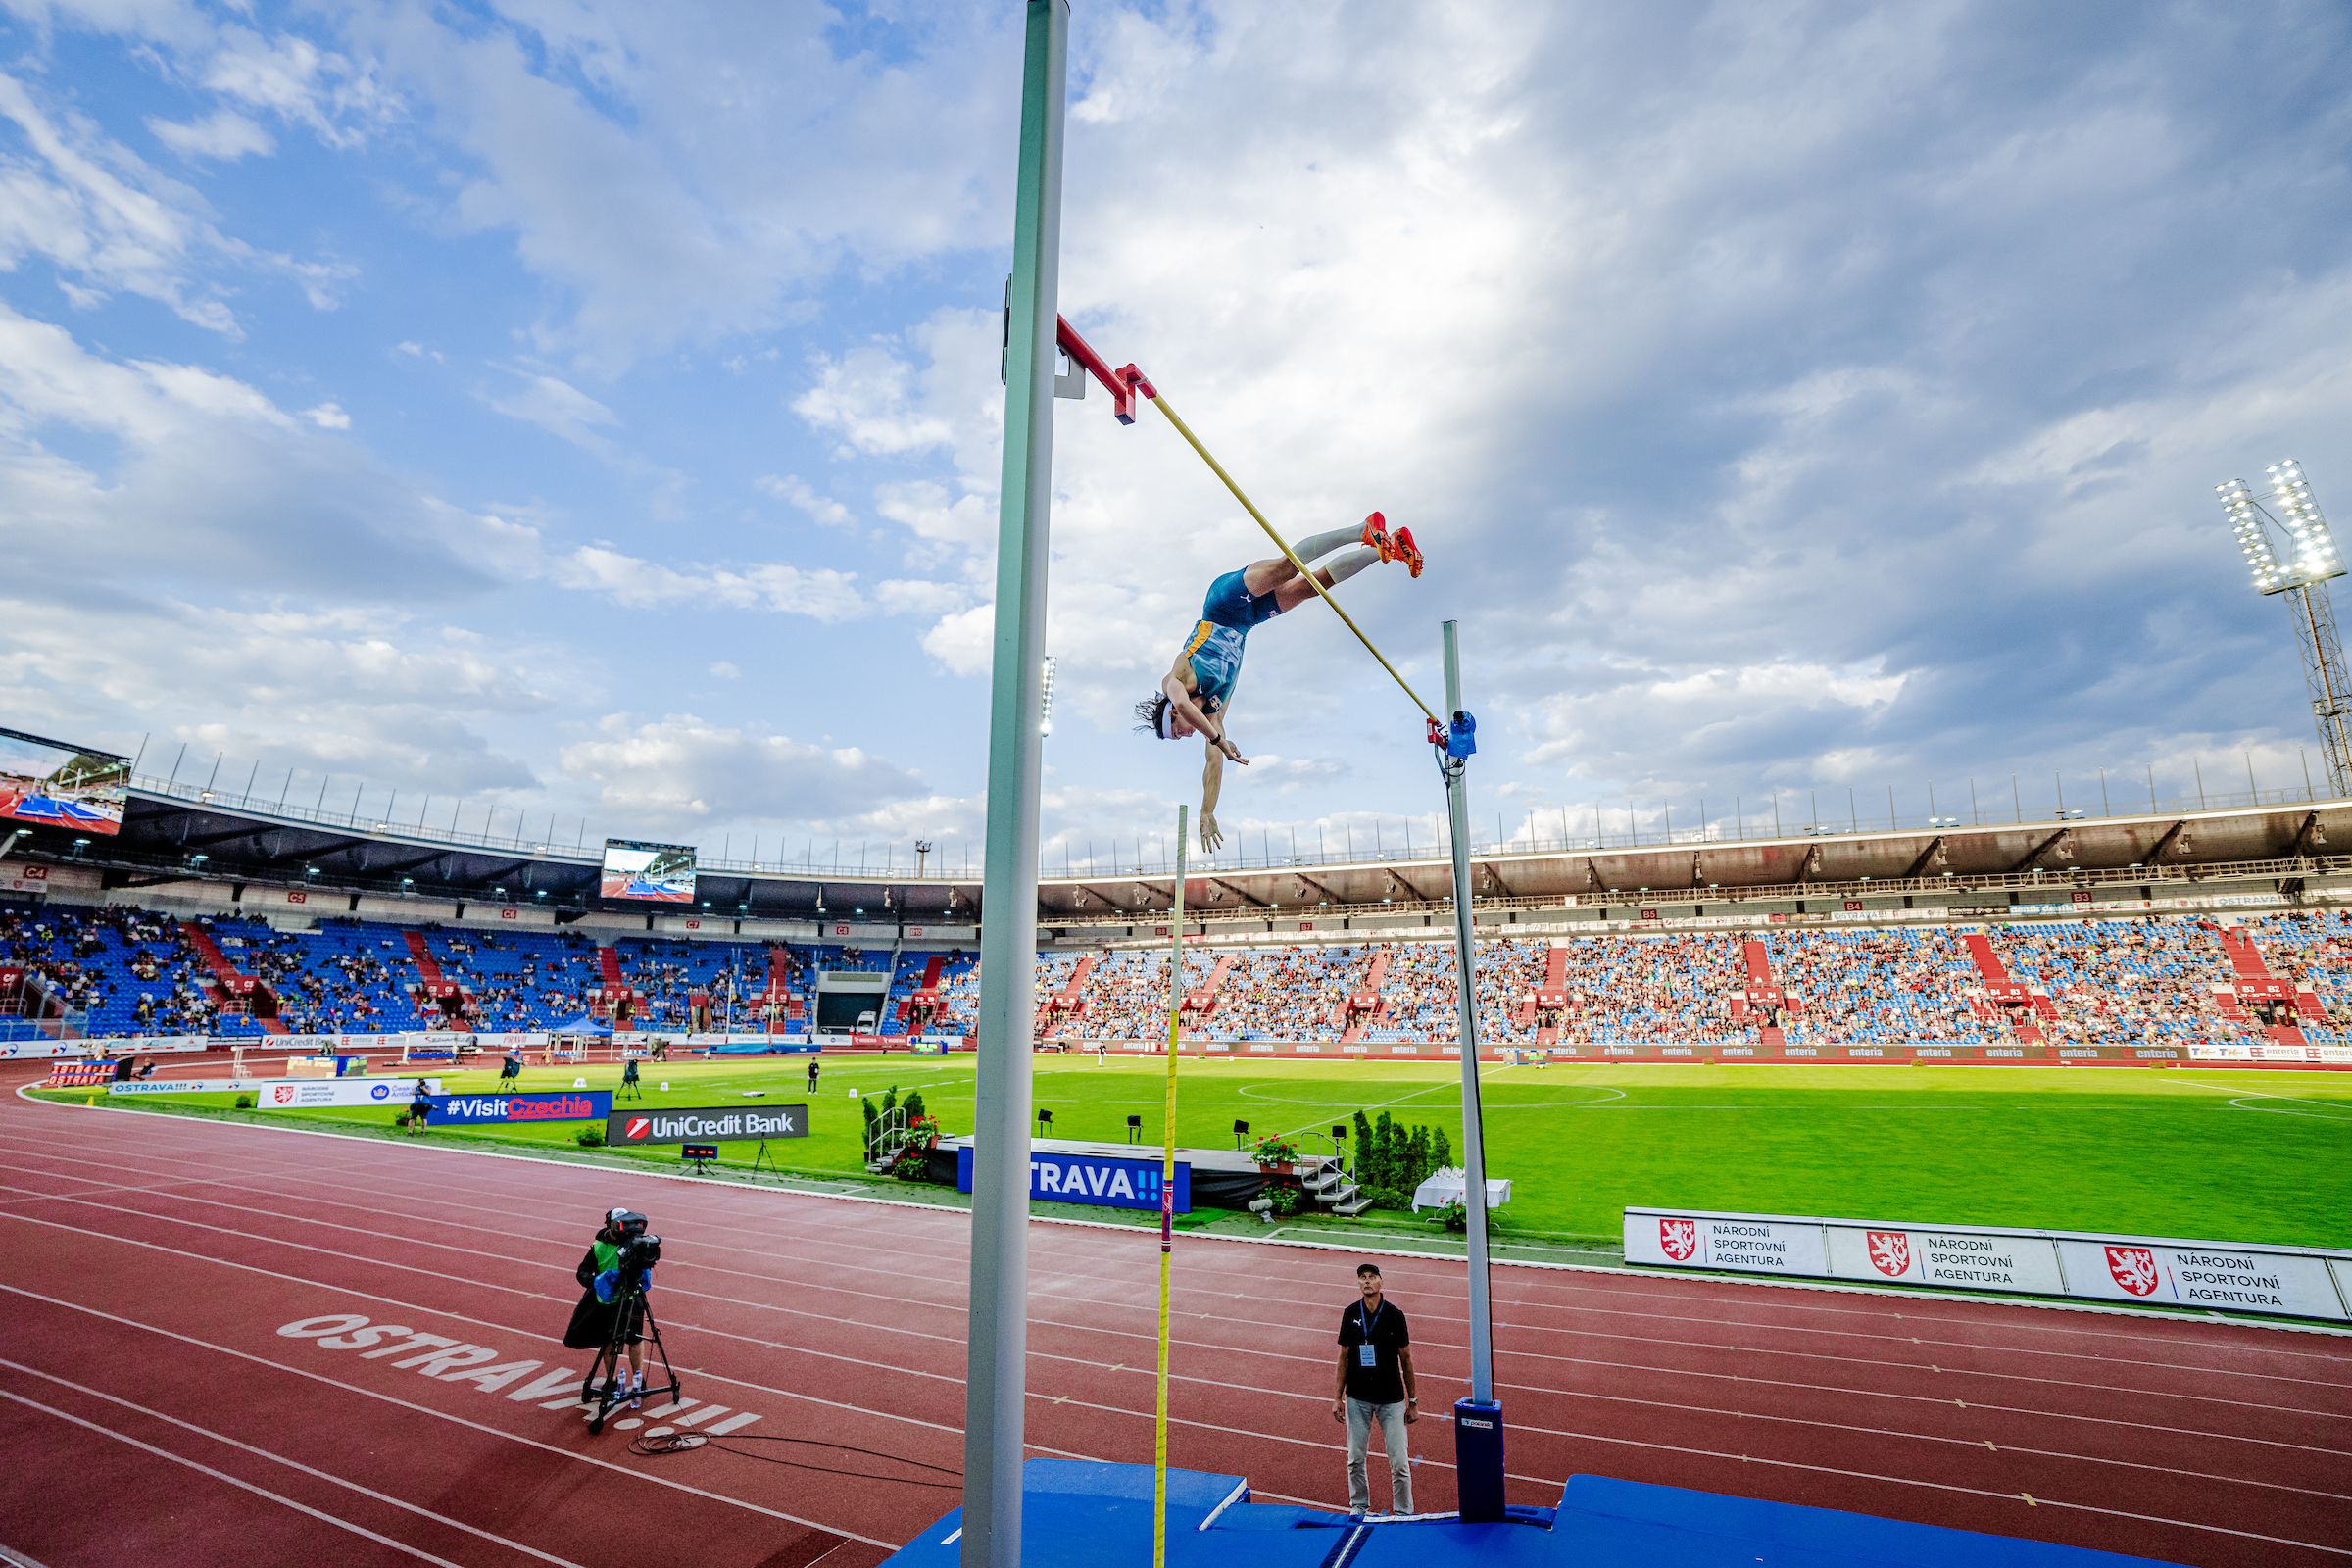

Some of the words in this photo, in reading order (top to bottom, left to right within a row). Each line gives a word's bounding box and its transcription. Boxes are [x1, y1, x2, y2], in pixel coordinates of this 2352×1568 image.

[26, 867, 45, 878] C4
[289, 893, 306, 903] C5
[2073, 893, 2089, 902] B3
[1846, 902, 1861, 911] B4
[504, 909, 516, 918] C6
[1642, 910, 1656, 919] B5
[275, 1036, 314, 1047] UniCredit
[1206, 1043, 1229, 1052] enteria
[1343, 1045, 1367, 1054] enteria
[1392, 1045, 1416, 1054] enteria
[1552, 1047, 1577, 1055] nteria
[1662, 1047, 1692, 1056] enteria
[1722, 1047, 1753, 1056] enteria
[1785, 1047, 1817, 1057] enteria
[1849, 1047, 1883, 1057] enteria
[1916, 1048, 1951, 1057] enteria
[1985, 1048, 2023, 1057] enteria
[2266, 1047, 2300, 1056] enteria
[2323, 1048, 2352, 1057] enteri
[2059, 1048, 2097, 1058] enteria
[2135, 1048, 2178, 1059] enteria
[51, 1064, 116, 1074] 19:04:14
[48, 1075, 105, 1085] OSTRAVA
[115, 1083, 187, 1092] OSTRAVA!!!
[446, 1096, 593, 1117] #VisitCzechia
[652, 1114, 742, 1138] UniCredit
[745, 1112, 795, 1134] Bank
[1713, 1222, 1770, 1238] NÁRODNÍ
[1714, 1239, 1786, 1252] SPORTOVNÍ
[1928, 1236, 1993, 1251] NÁRODNÍ
[1715, 1253, 1784, 1267] AGENTURA
[1931, 1253, 2013, 1268] SPORTOVNÍ
[2177, 1252, 2255, 1270] NÁRODNÍ
[1935, 1268, 2014, 1284] AGENTURA
[2181, 1271, 2281, 1290] SPORTOVNÍ
[2188, 1288, 2283, 1306] AGENTURA
